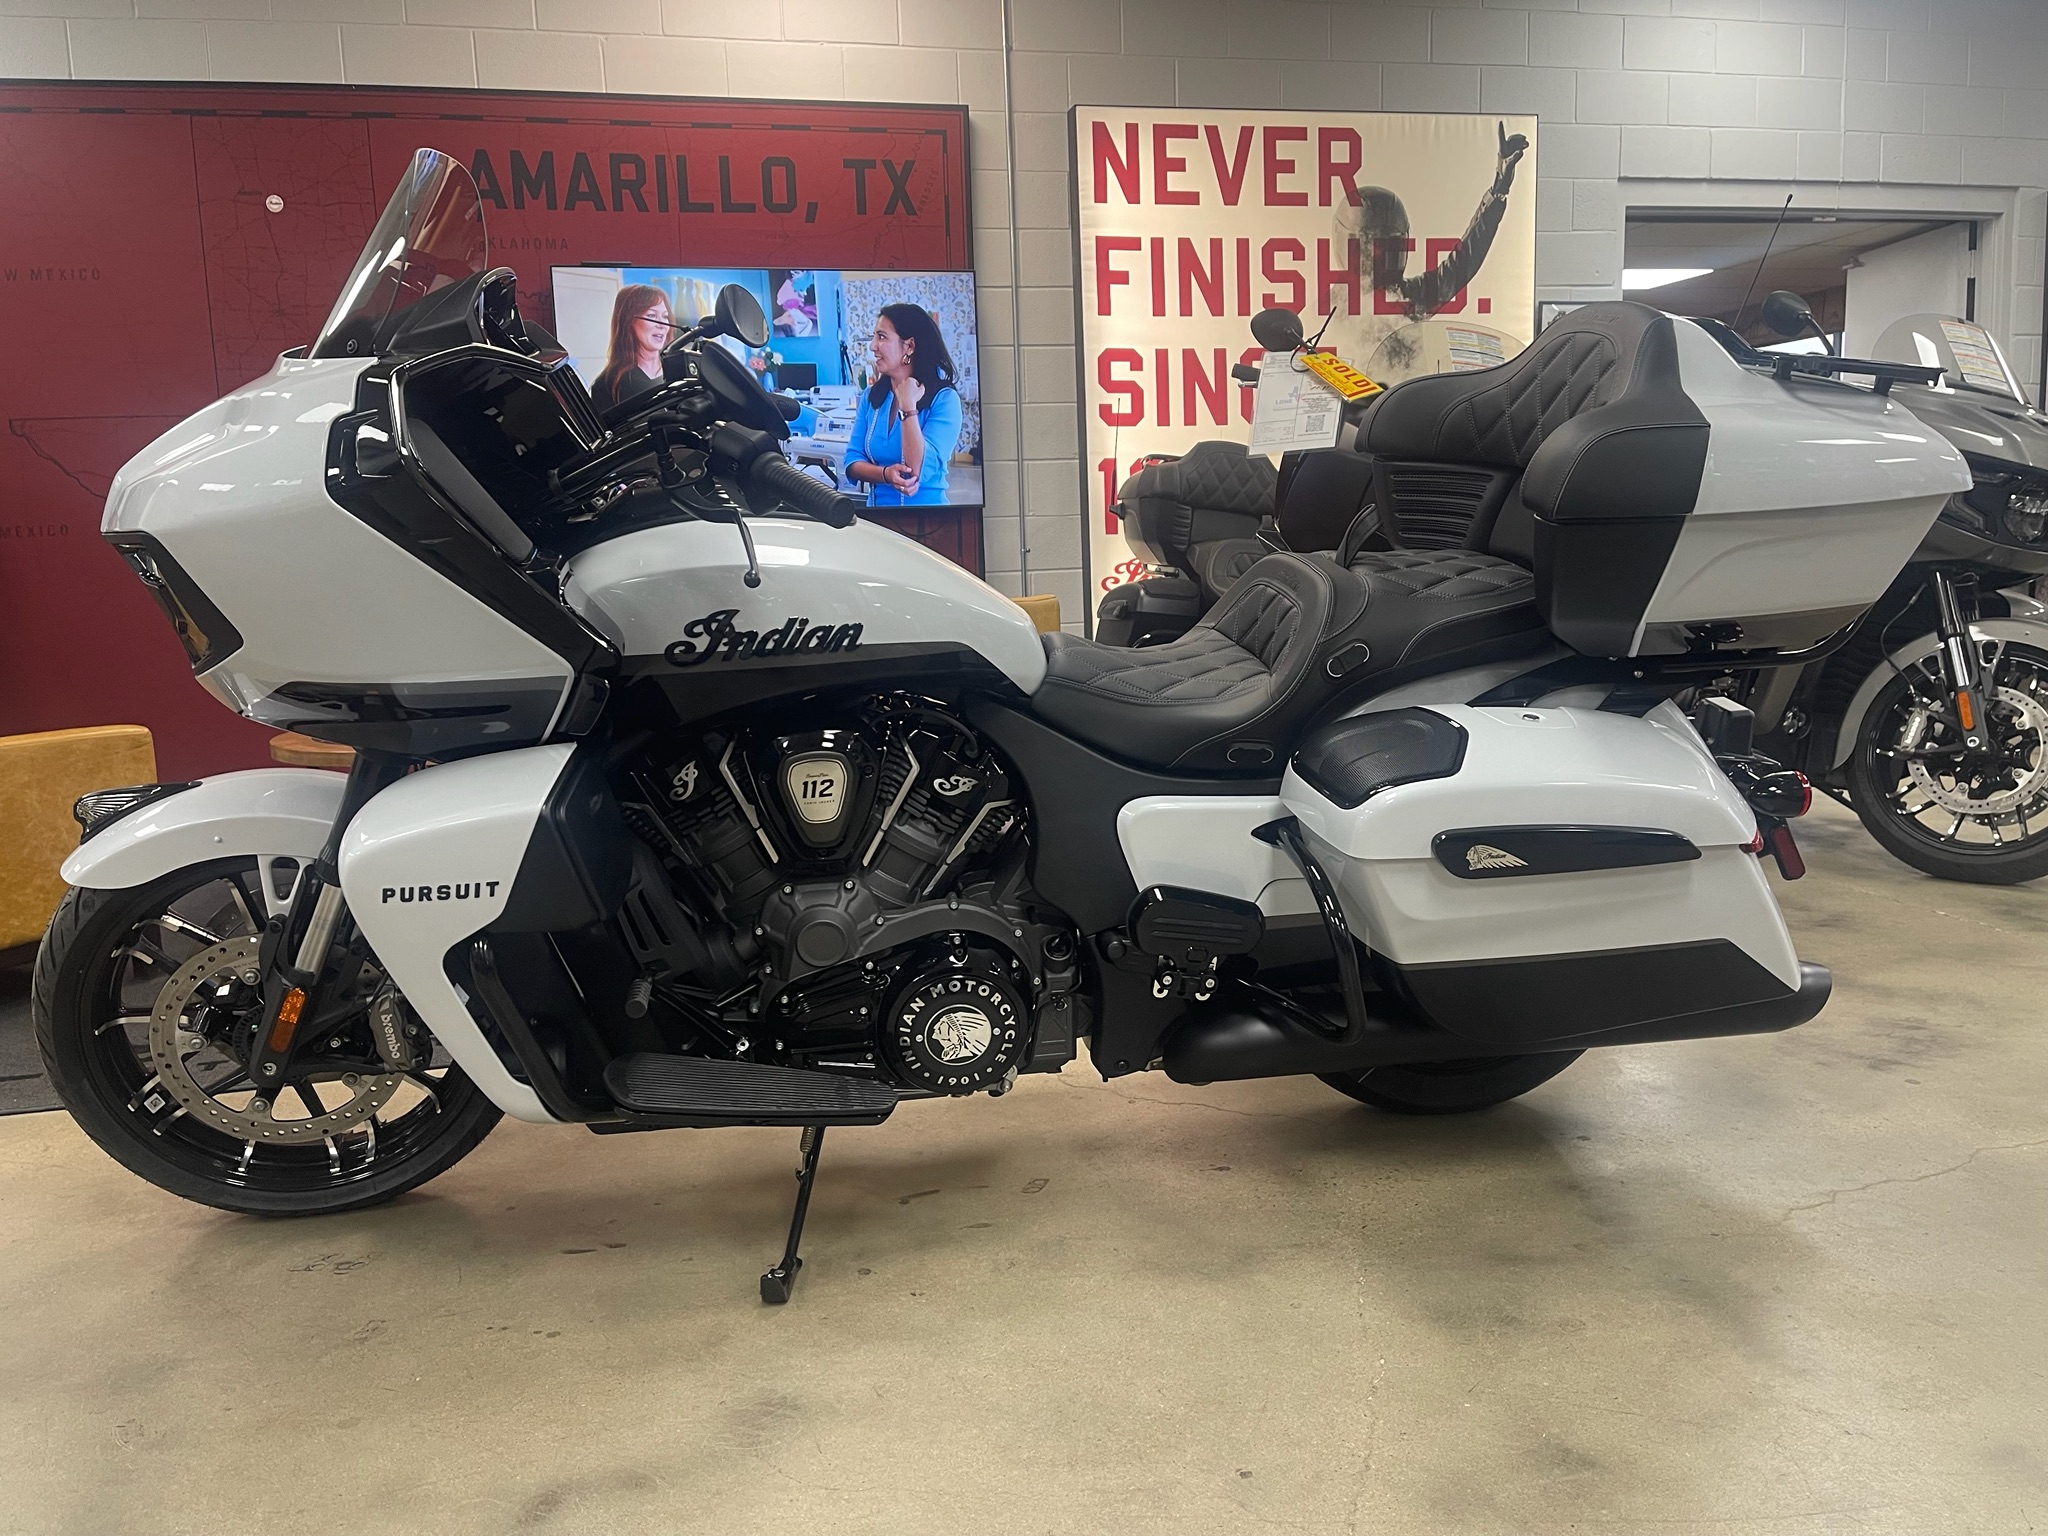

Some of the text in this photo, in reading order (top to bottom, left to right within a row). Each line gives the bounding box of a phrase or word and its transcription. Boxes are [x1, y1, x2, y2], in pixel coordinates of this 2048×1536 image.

[470, 149, 919, 224] AMARILLO, TX
[1092, 121, 1363, 207] NEVER
[30, 267, 100, 281] MEXICO
[1096, 236, 1492, 317] FINISHED.
[664, 609, 864, 667] Indian
[802, 778, 834, 799] 112
[382, 881, 500, 903] PURSUIT
[380, 1013, 401, 1059] brembo
[899, 979, 1016, 1070] INDIAN MOTORCYCLE
[937, 1072, 980, 1086] 1901
